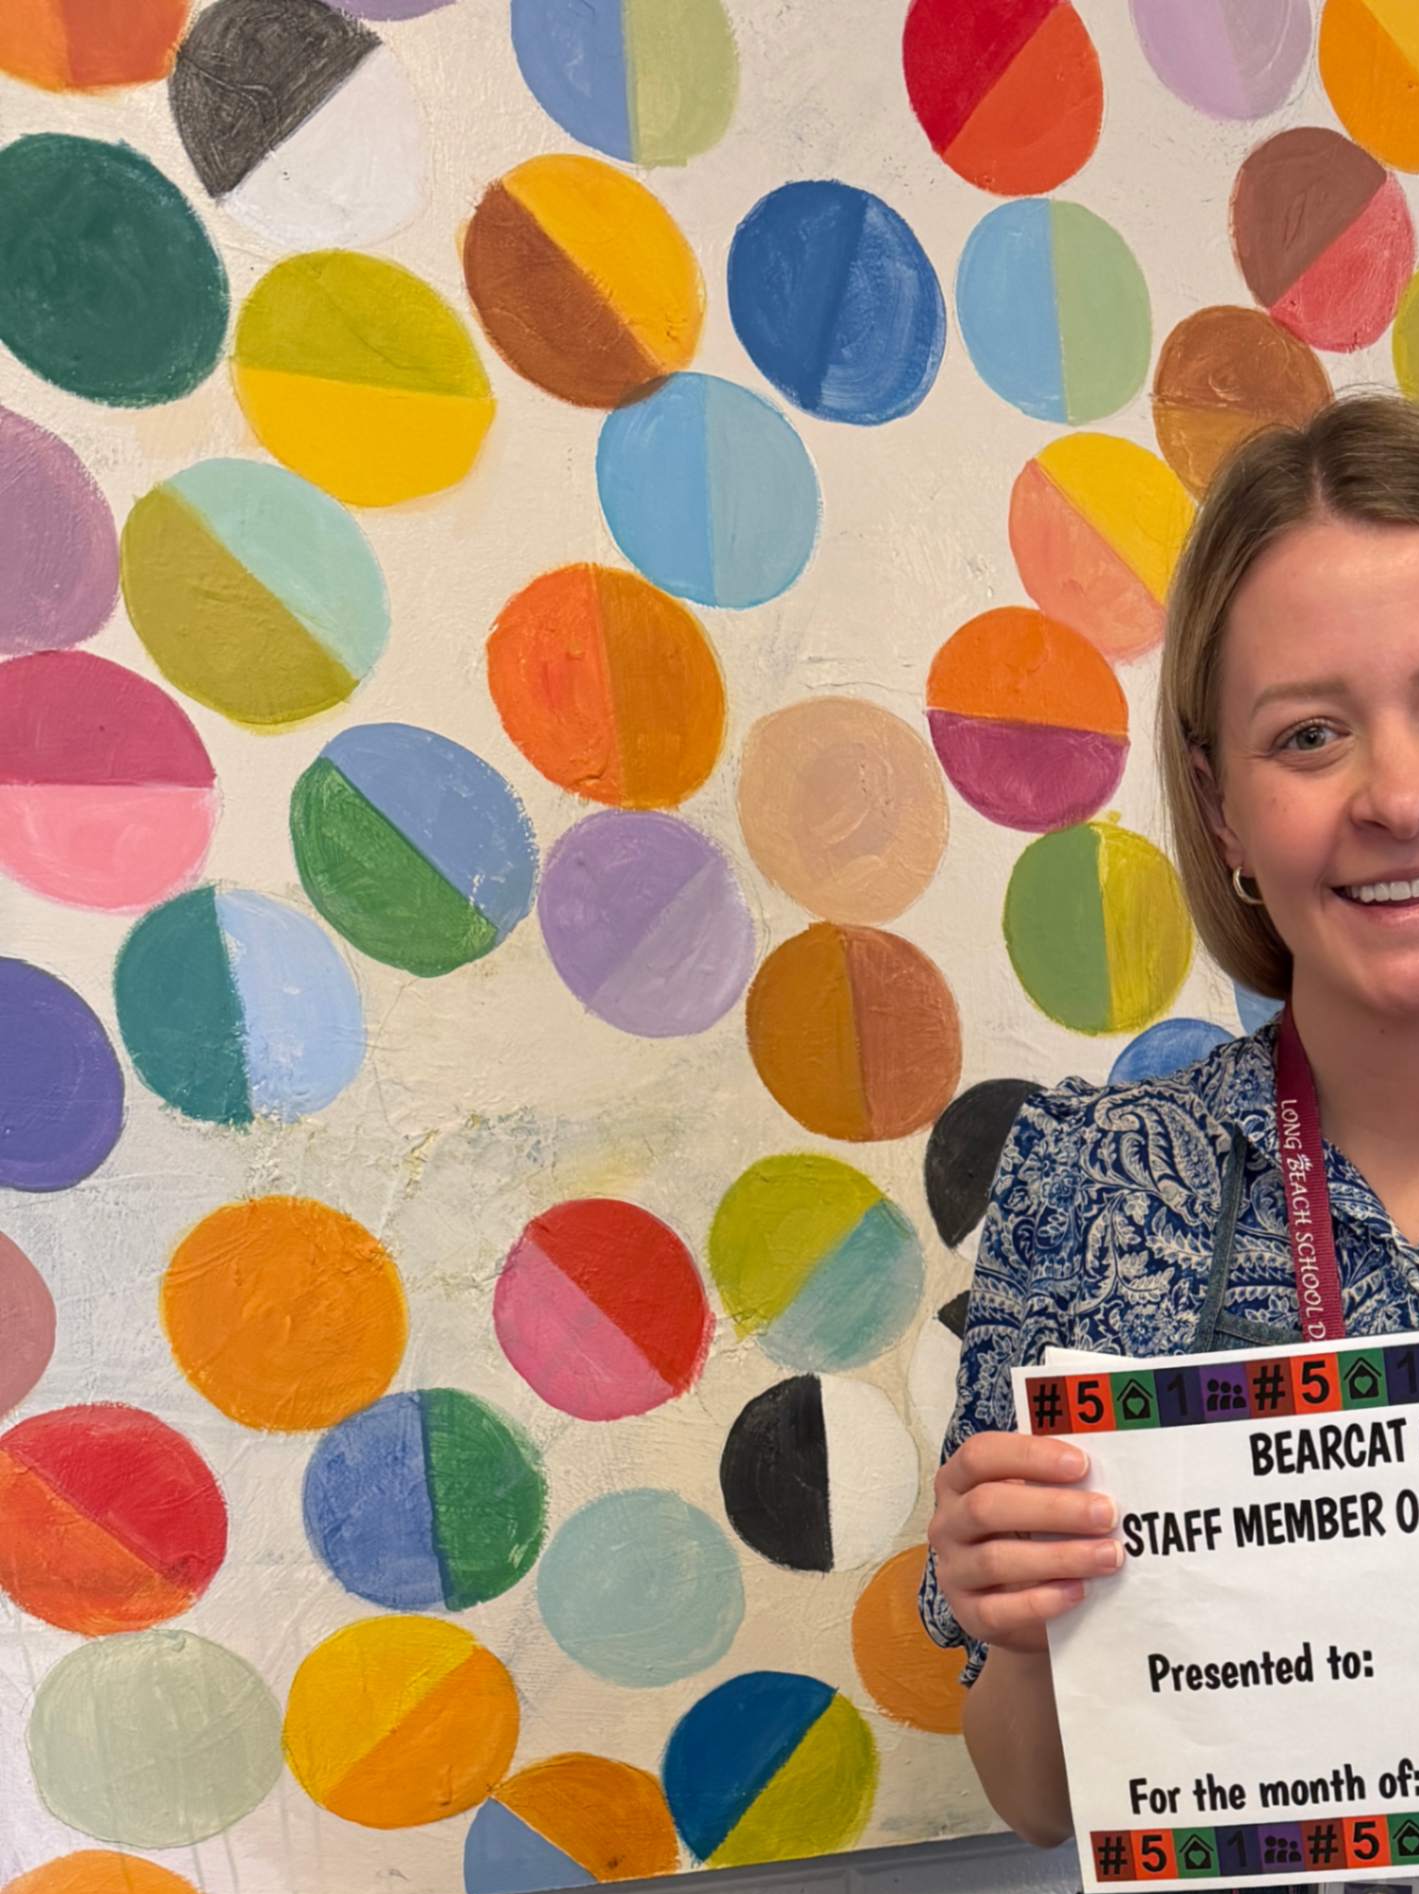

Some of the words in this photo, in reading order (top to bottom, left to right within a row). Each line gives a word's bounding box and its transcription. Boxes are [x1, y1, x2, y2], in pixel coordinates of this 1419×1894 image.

[1280, 1099, 1303, 1150] LONG
[1286, 1154, 1312, 1226] BEACH
[1295, 1229, 1325, 1322] SCHOOL
[1249, 1417, 1407, 1477] BEARCAT
[1122, 1507, 1222, 1557] STAFF
[1233, 1491, 1387, 1548] MEMBER
[1148, 1642, 1314, 1693] Presented
[1327, 1646, 1375, 1680] to:
[1129, 1777, 1181, 1815] For
[1193, 1773, 1247, 1811] the
[1259, 1764, 1366, 1808] month
